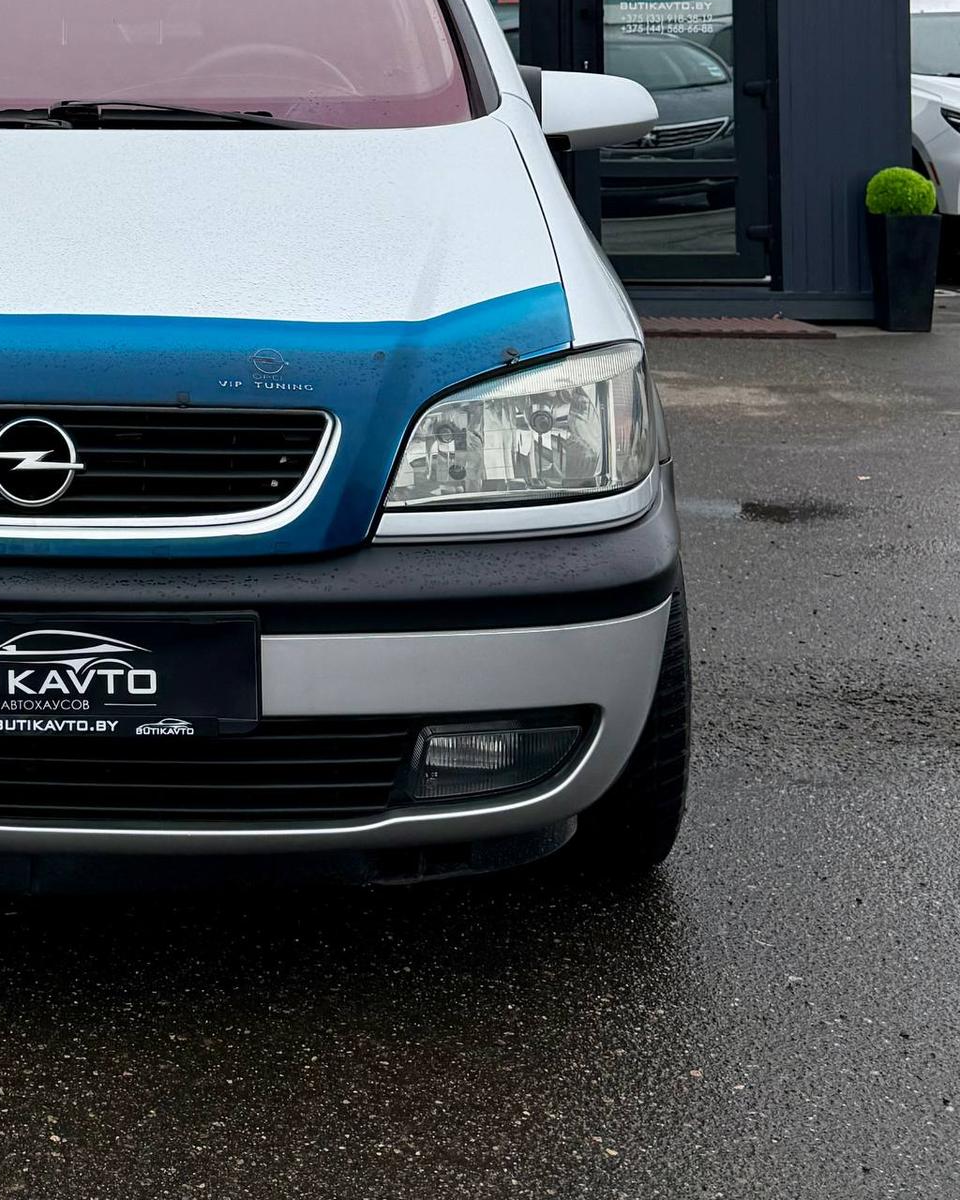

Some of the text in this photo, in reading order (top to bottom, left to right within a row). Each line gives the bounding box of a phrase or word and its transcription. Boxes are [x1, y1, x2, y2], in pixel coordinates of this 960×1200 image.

[619, 1, 713, 10] BUTIKAVTO.BY
[218, 380, 315, 391] VIP TUNING
[1, 699, 90, 711] АВТОХАУСОВ
[135, 726, 195, 735] BUTIKAVTO
